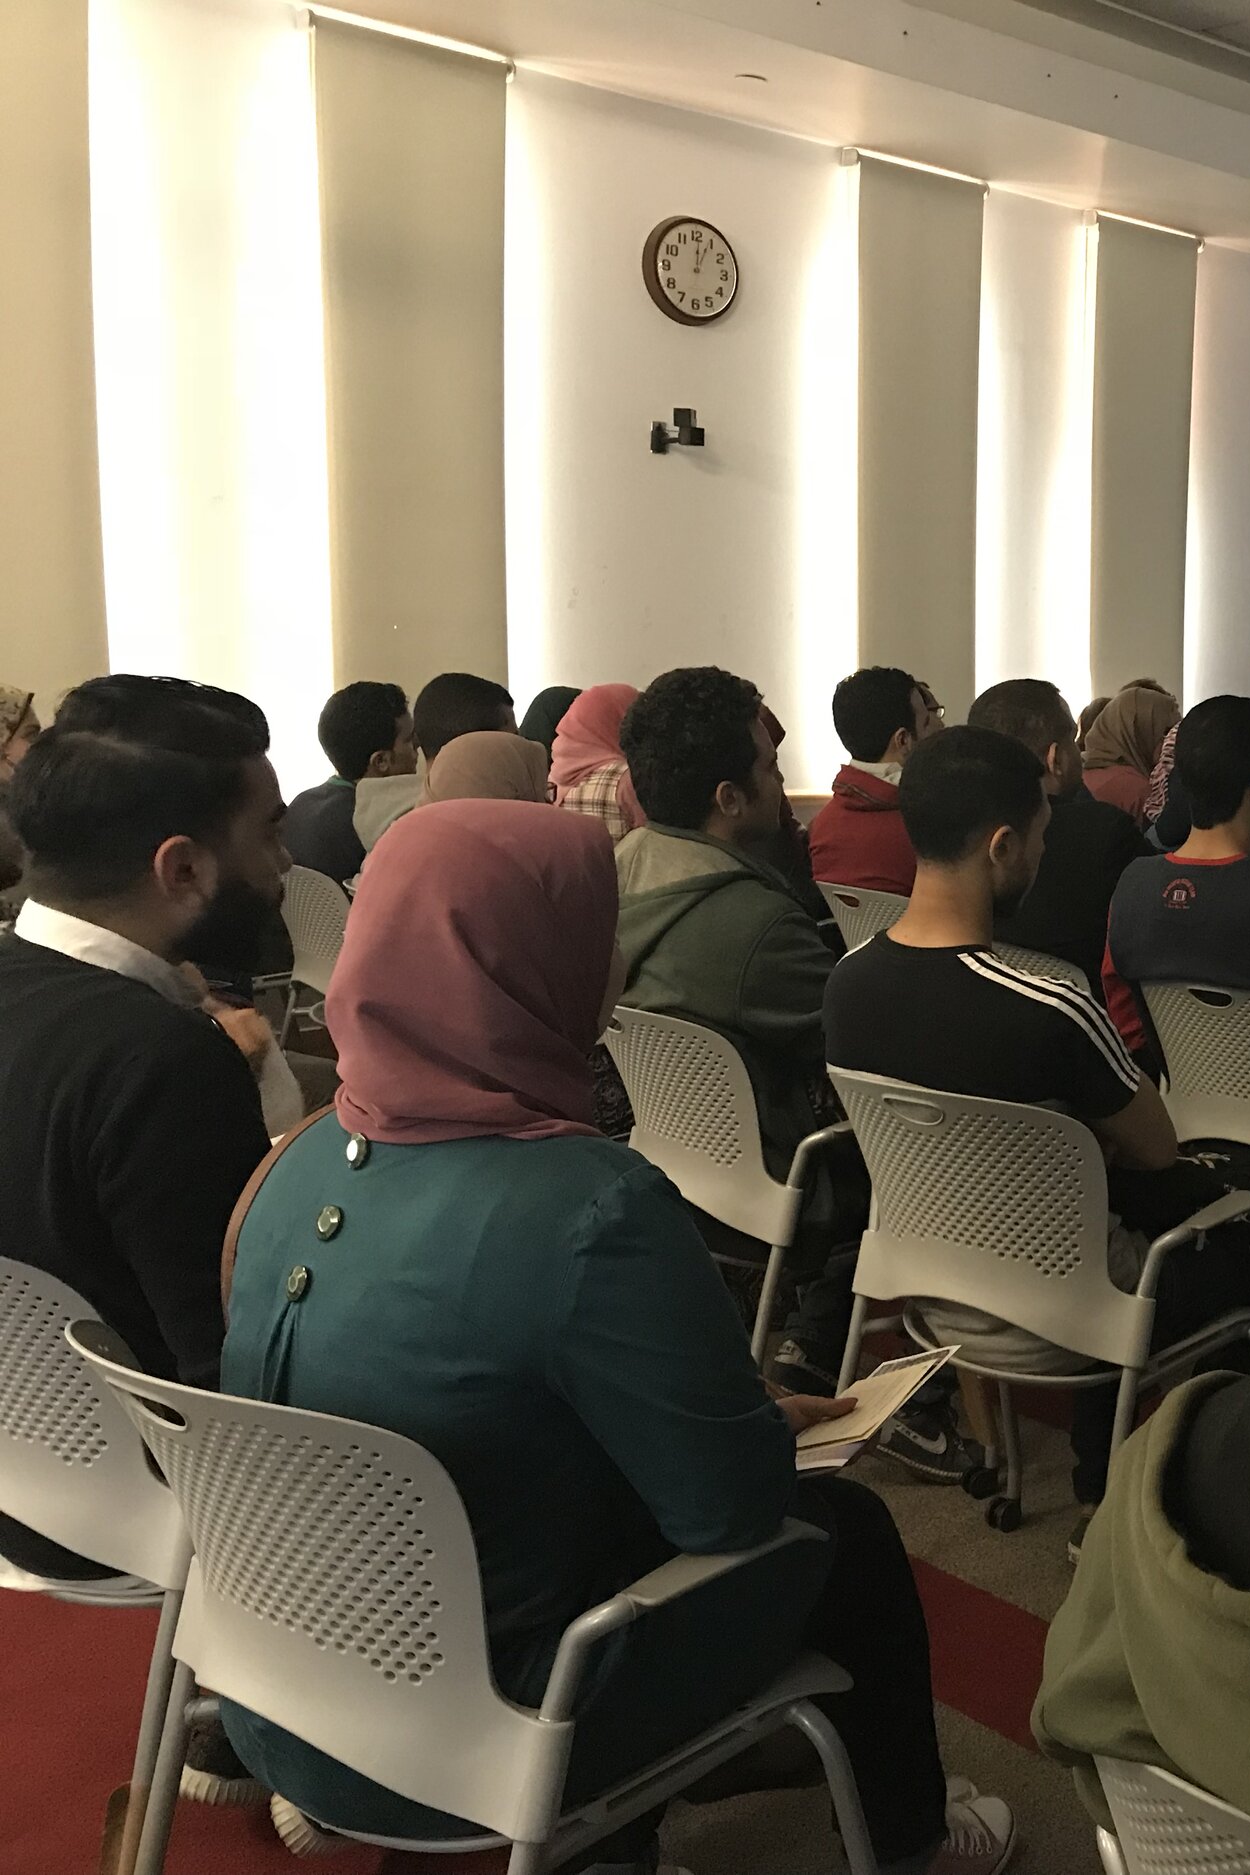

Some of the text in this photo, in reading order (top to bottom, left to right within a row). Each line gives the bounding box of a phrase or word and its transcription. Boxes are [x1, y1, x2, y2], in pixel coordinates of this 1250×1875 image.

[678, 232, 687, 244] 11
[691, 230, 703, 242] 12
[666, 244, 678, 256] 10
[710, 239, 713, 249] 1
[716, 253, 724, 264] 2
[662, 259, 671, 271] 9
[720, 270, 728, 281] 3
[667, 277, 675, 289] 8
[677, 291, 686, 303] 7
[715, 286, 723, 297] 4
[691, 298, 700, 310] 6
[705, 296, 713, 308] 5
